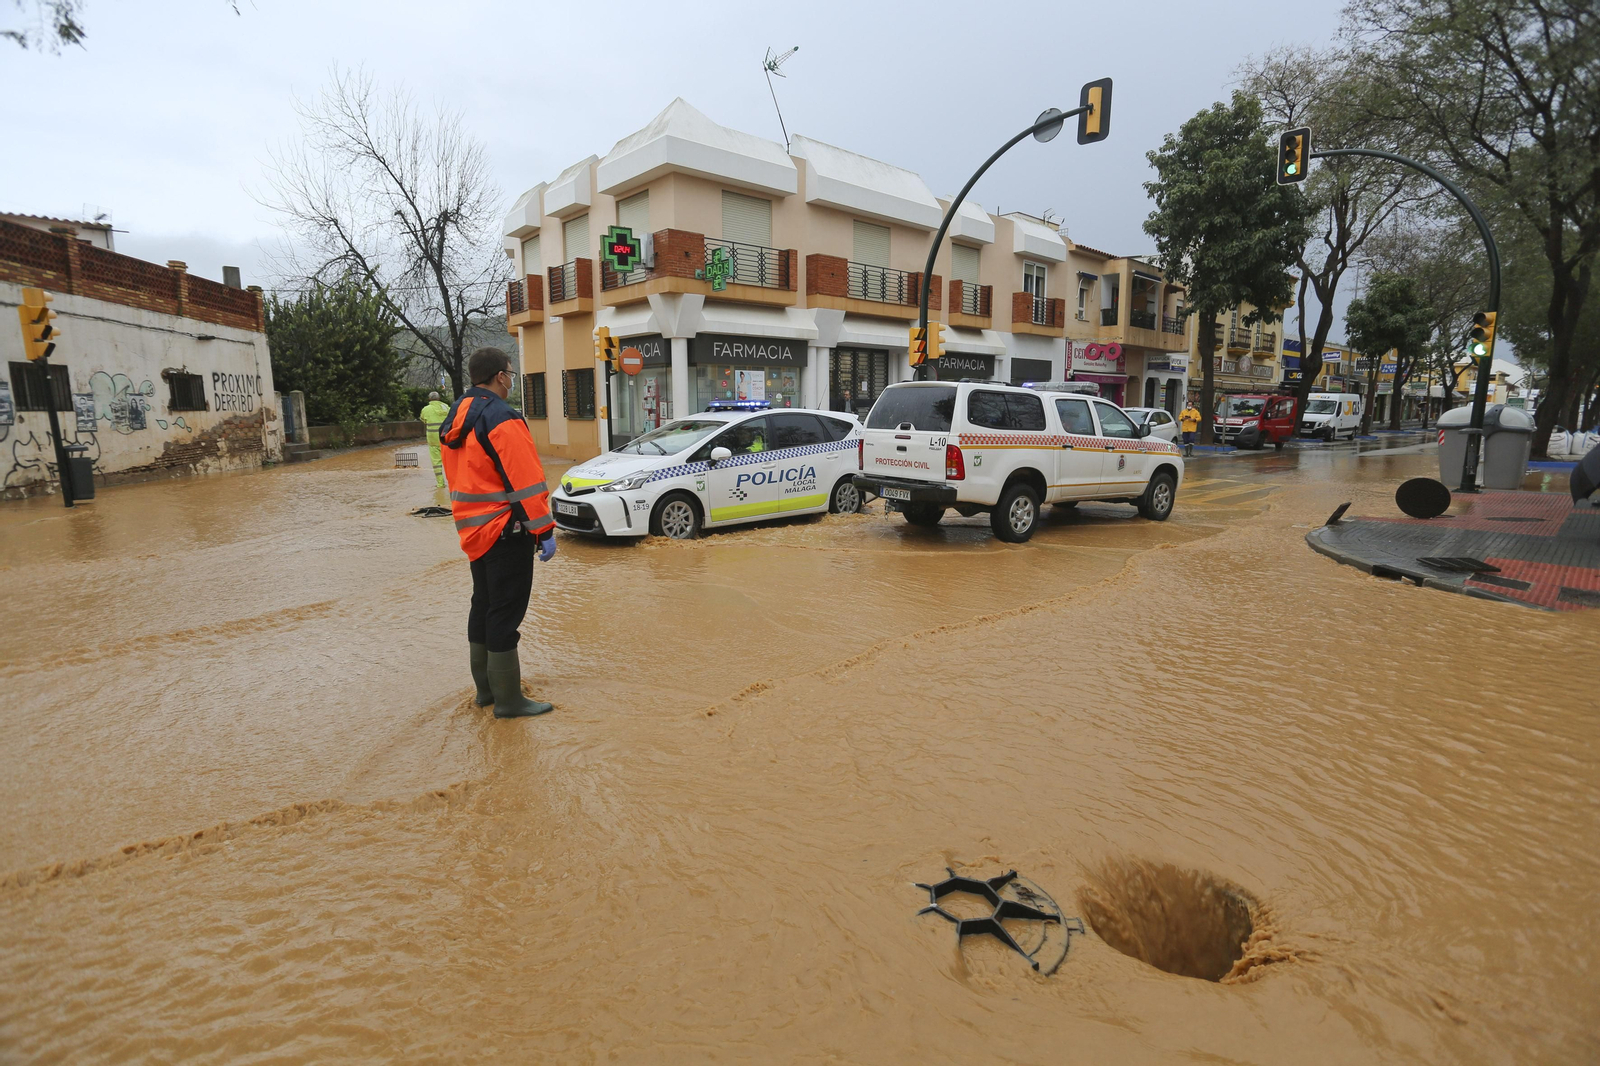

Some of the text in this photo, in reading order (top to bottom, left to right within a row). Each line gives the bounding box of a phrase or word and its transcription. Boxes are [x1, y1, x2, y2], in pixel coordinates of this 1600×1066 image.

[713, 342, 793, 360] FARMACIA
[939, 357, 986, 371] FARMACIA
[212, 371, 263, 397] PROXIMO
[214, 392, 254, 413] DERRIBO
[930, 437, 947, 447] L-10
[875, 457, 930, 470] PROTECCIÓN CIVIL
[736, 464, 816, 487] POLICÍA
[792, 478, 816, 487] LOCAL
[884, 488, 910, 499] 0049 FVX
